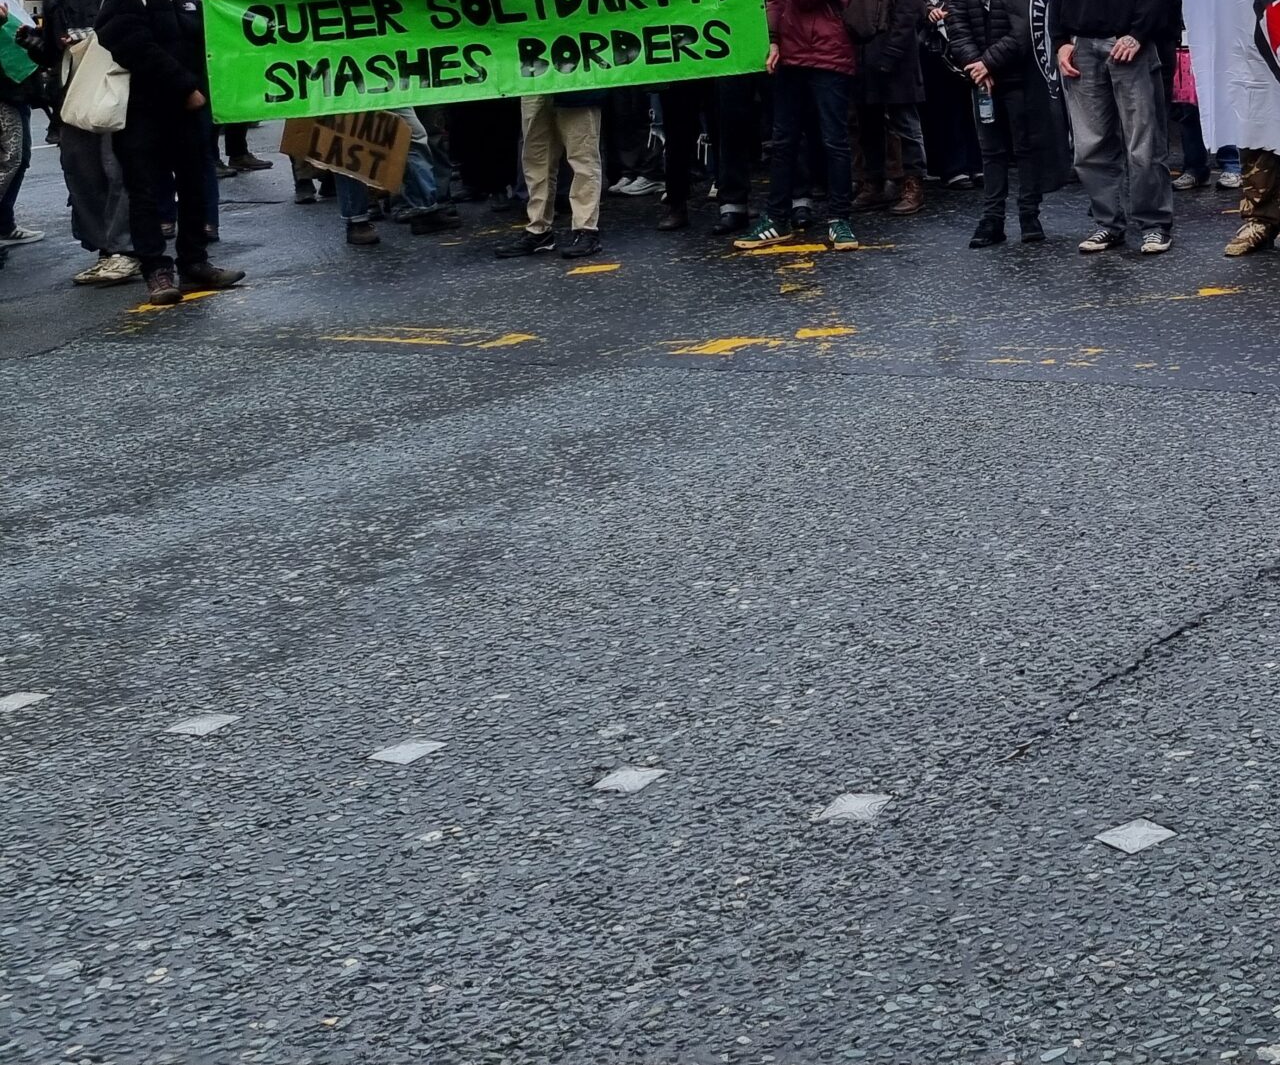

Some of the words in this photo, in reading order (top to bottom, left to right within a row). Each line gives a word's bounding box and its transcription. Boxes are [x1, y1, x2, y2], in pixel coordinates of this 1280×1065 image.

[264, 43, 491, 103] SMASHES
[518, 20, 732, 78] BORDERS
[308, 126, 387, 179] LAST
